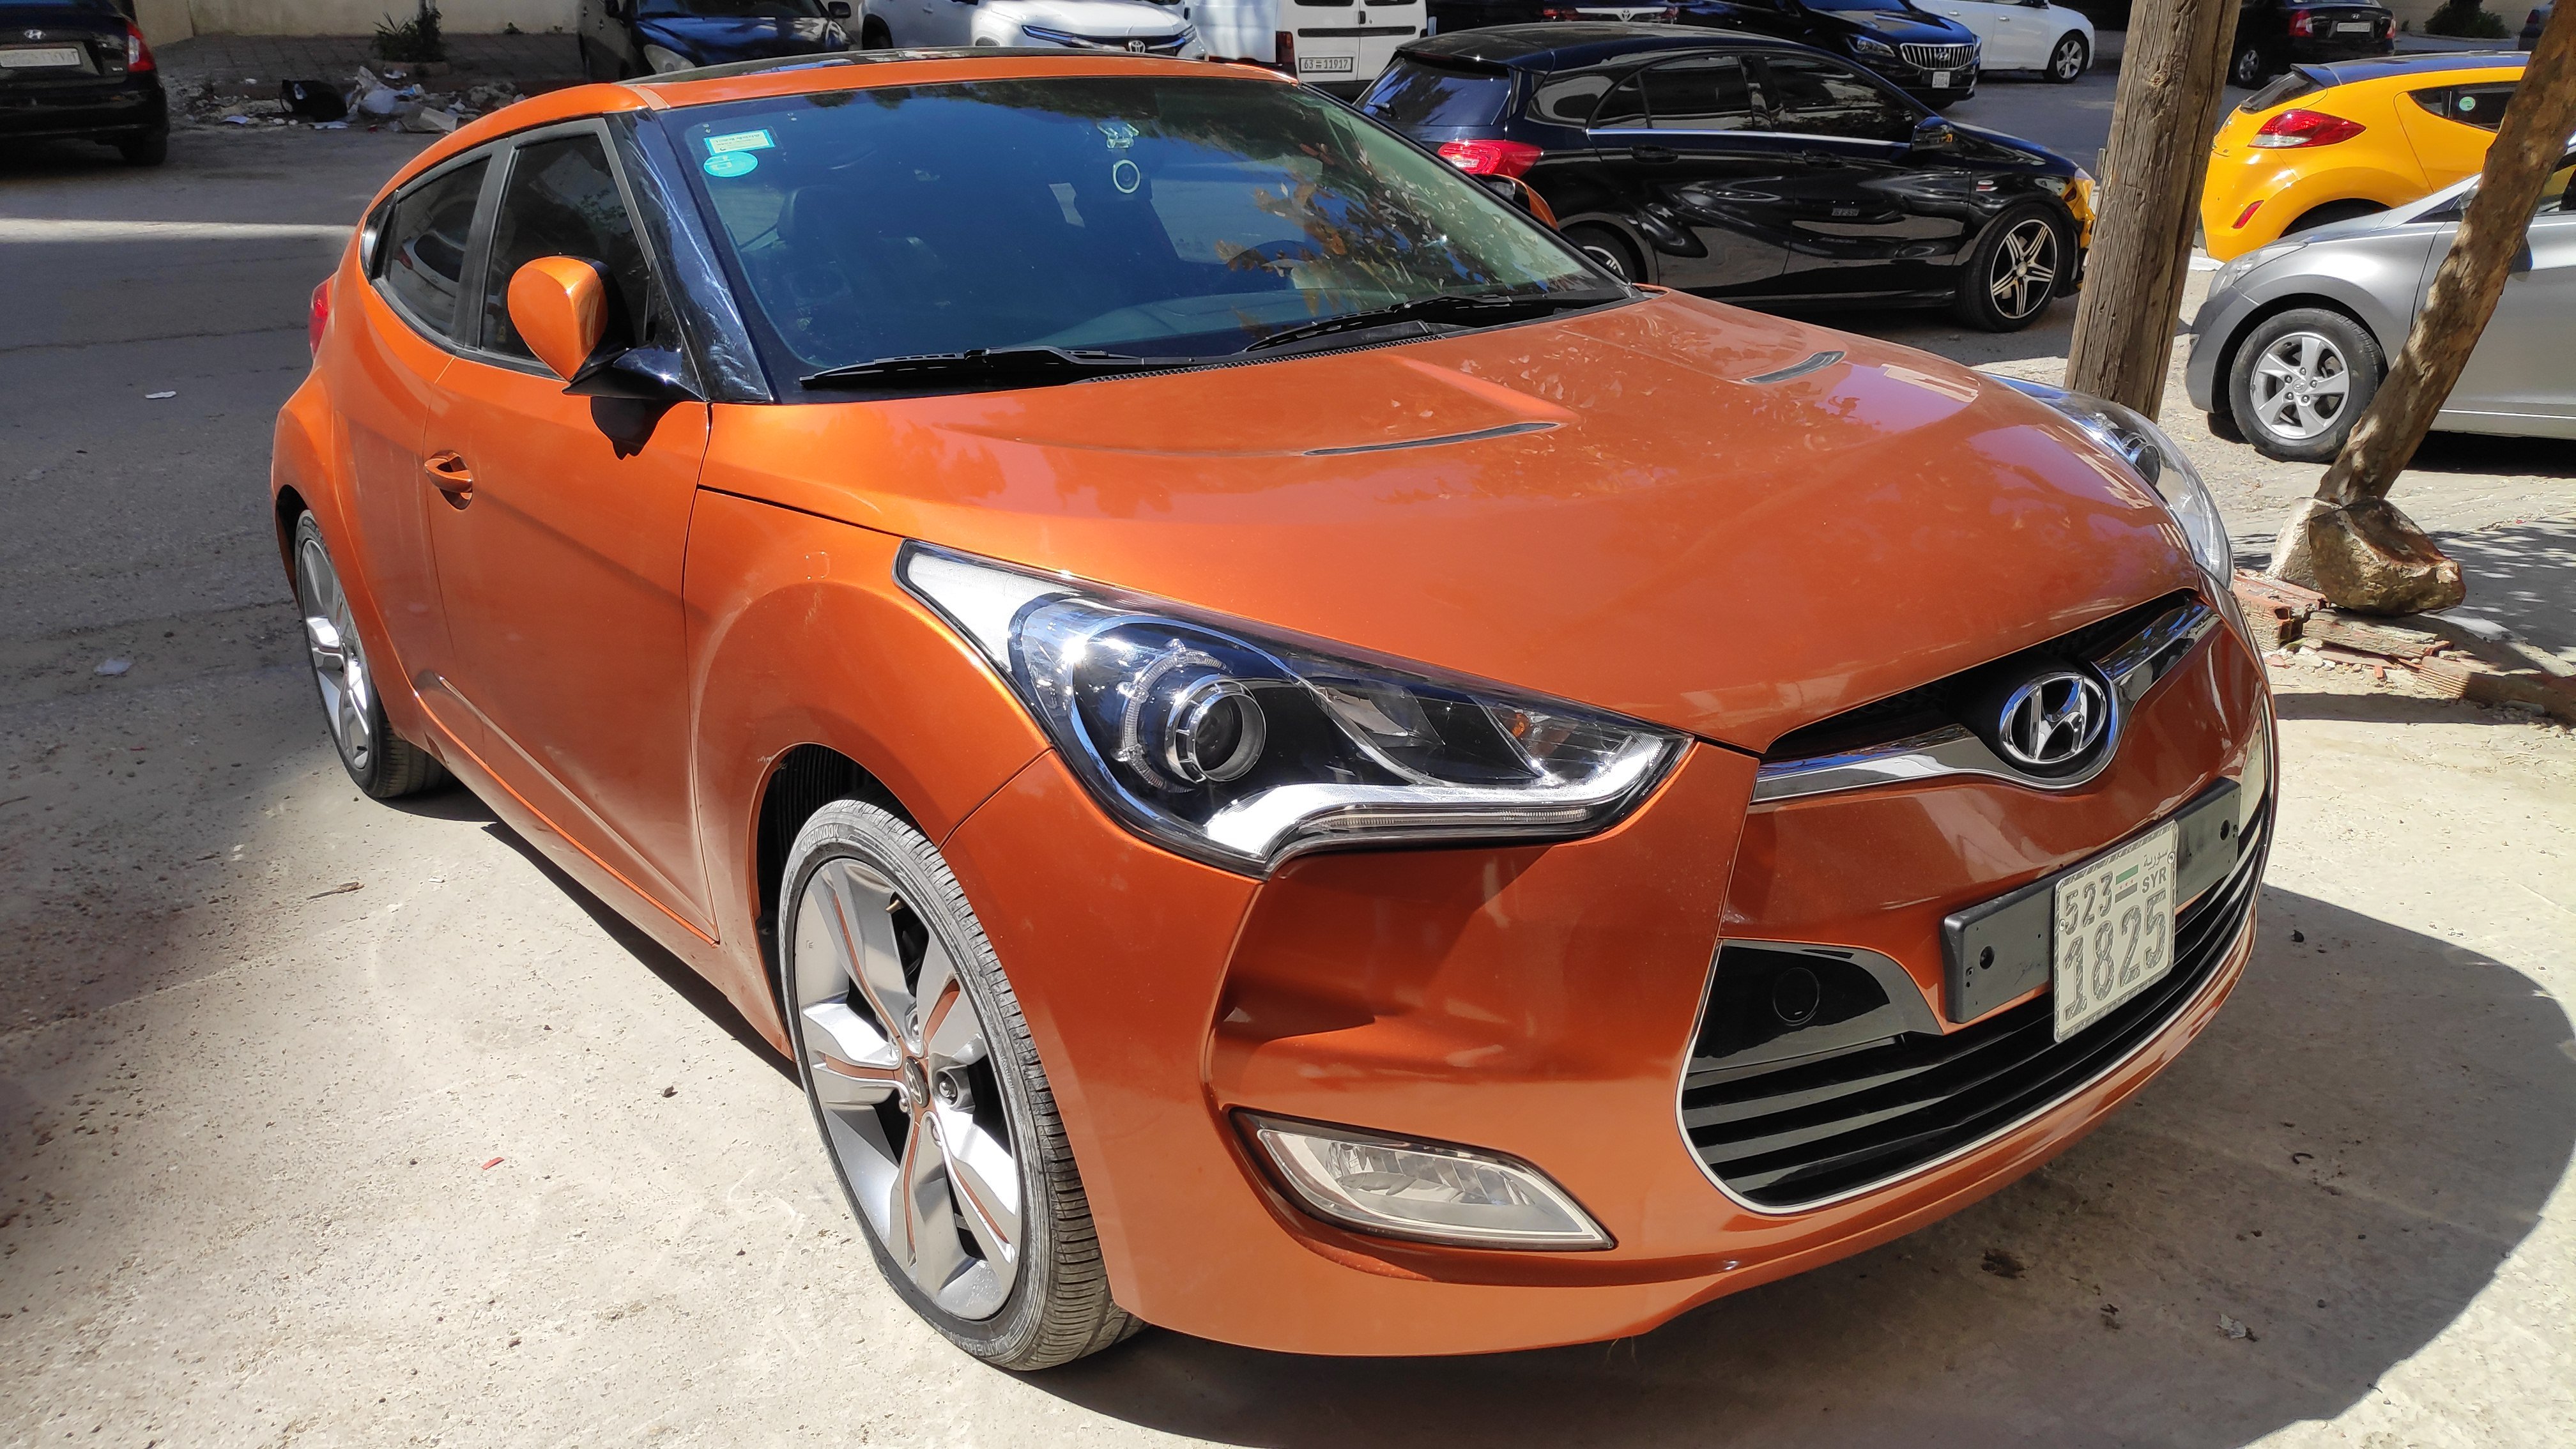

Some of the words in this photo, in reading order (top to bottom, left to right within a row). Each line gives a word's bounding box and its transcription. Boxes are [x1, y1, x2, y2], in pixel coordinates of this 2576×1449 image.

[1304, 59, 1314, 69] 63
[2143, 848, 2168, 871] سورية
[2142, 866, 2166, 893] SYR
[2064, 871, 2113, 935] 523
[2064, 888, 2166, 1022] 1825
